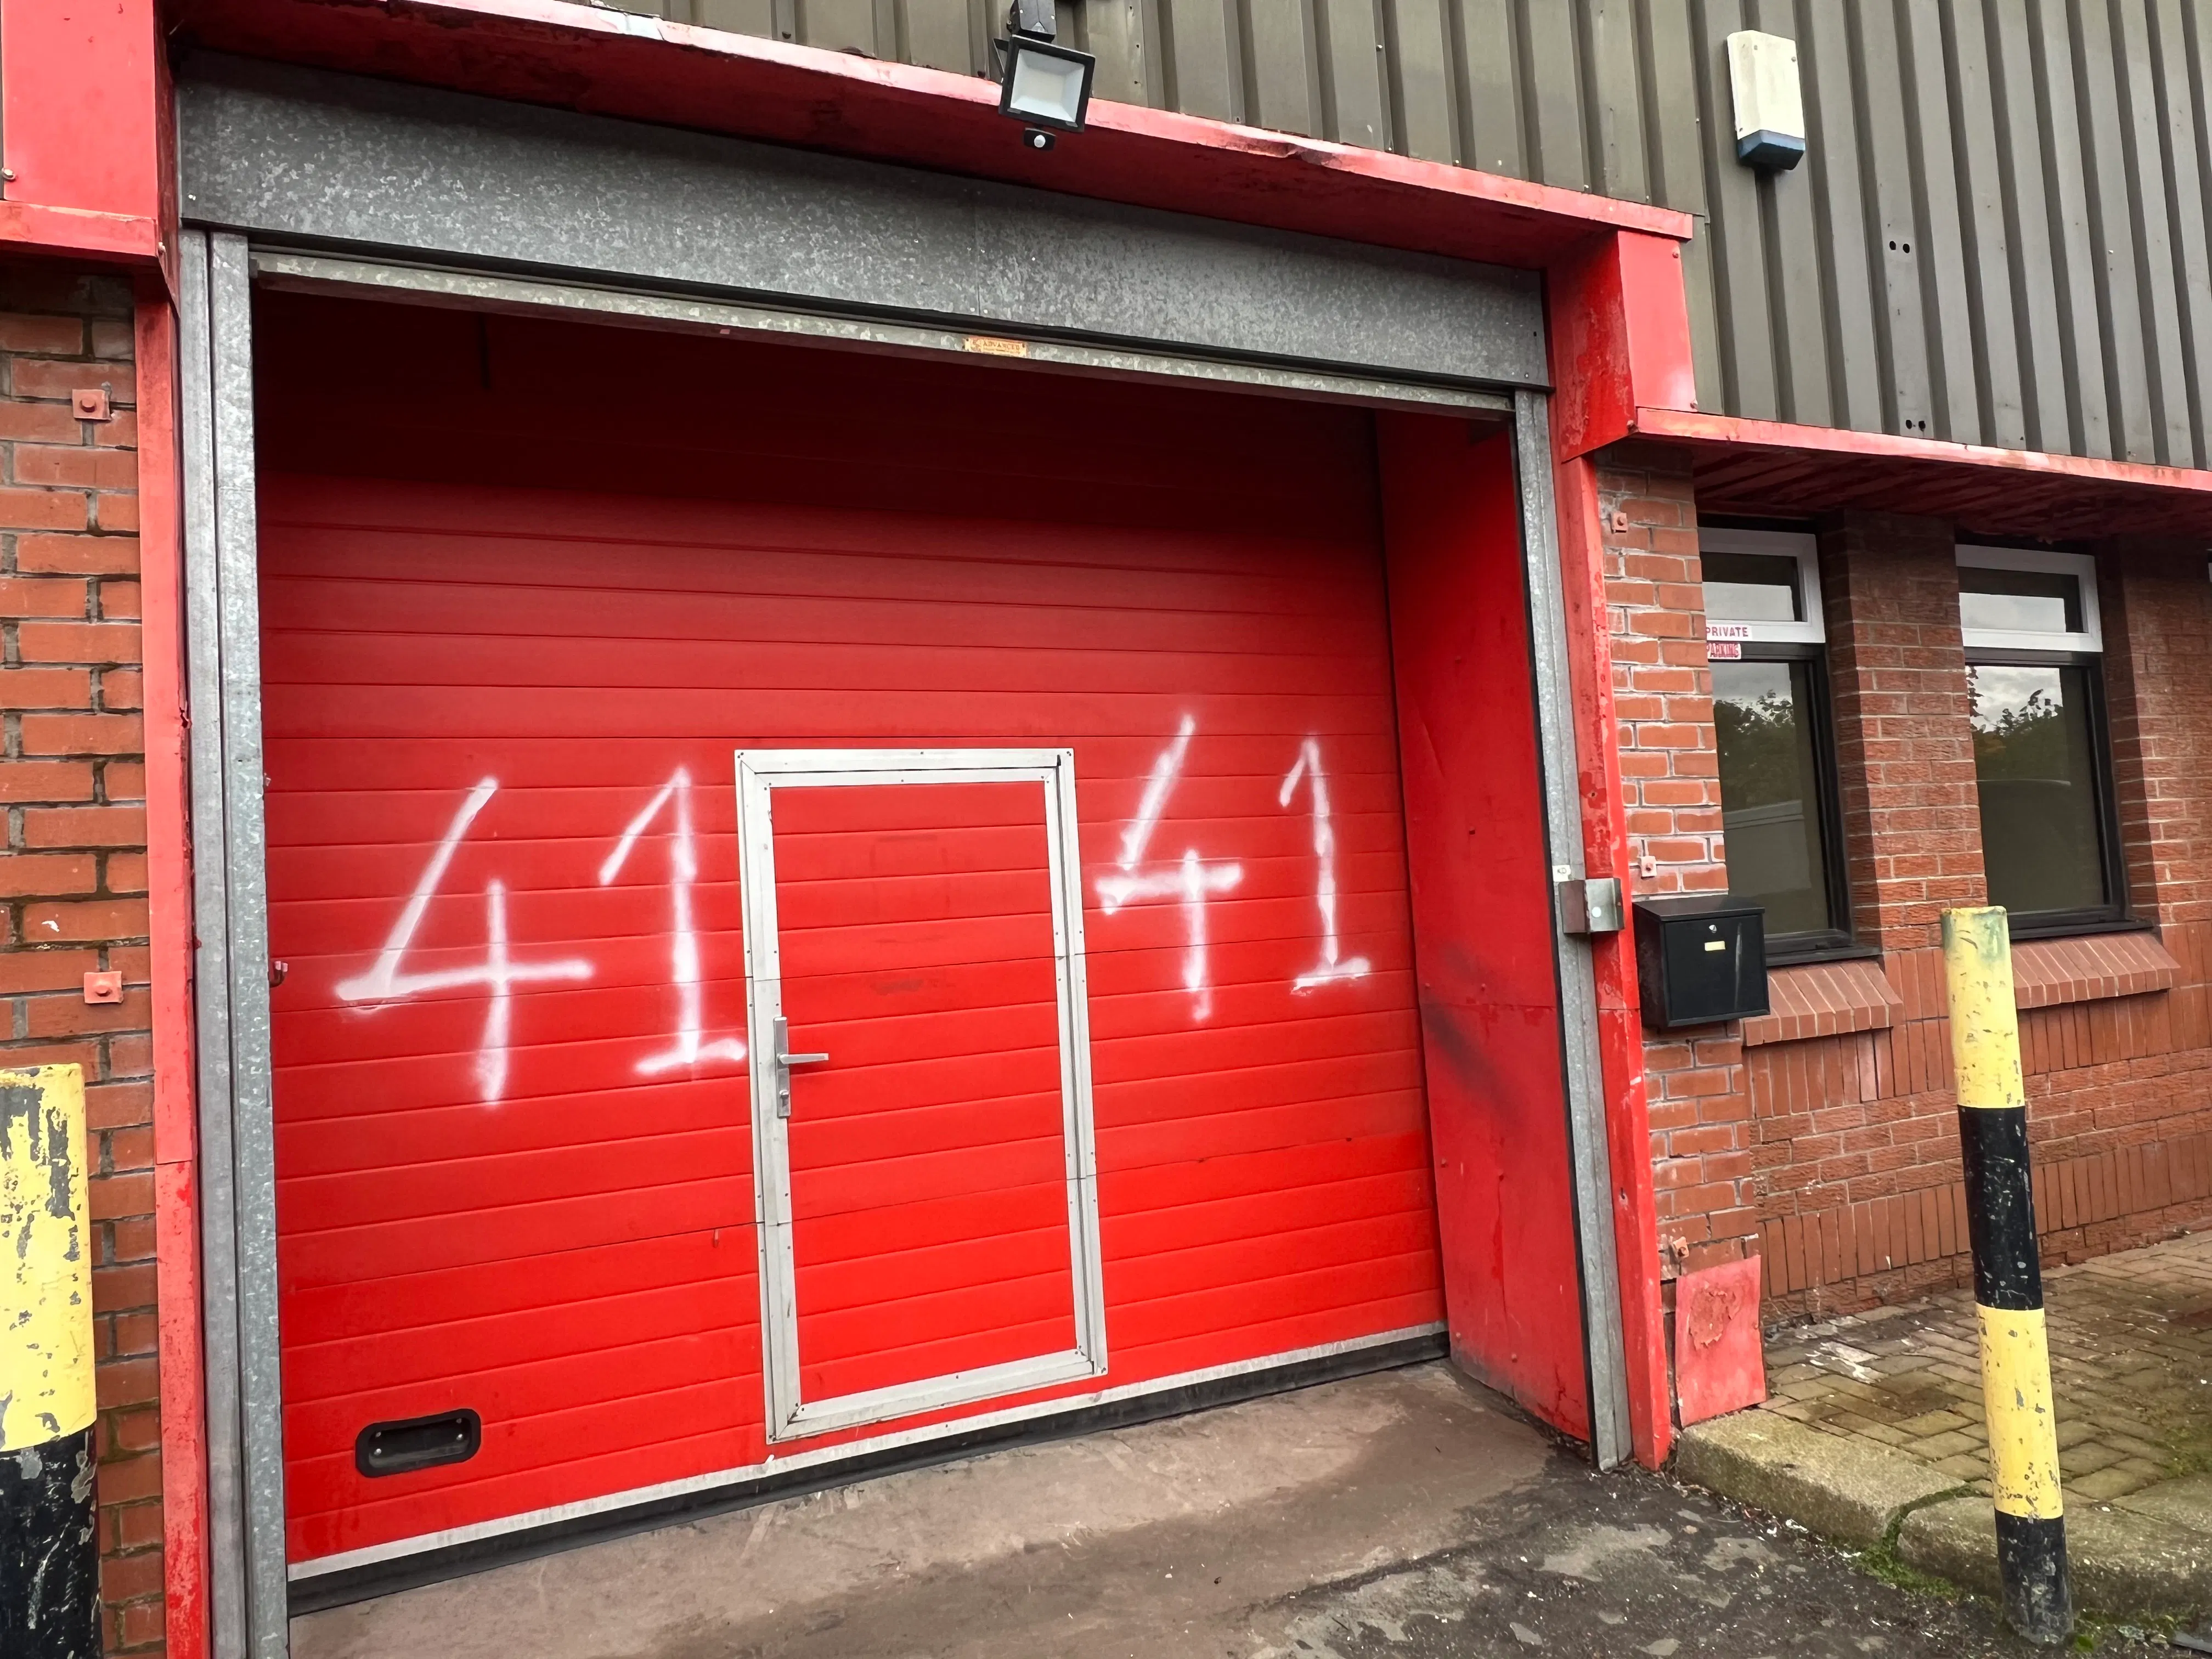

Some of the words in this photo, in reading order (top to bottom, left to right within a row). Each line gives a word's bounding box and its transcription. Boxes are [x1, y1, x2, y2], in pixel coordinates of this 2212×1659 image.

[1706, 627, 1748, 637] PRIVATE
[336, 767, 746, 1105] 41
[1097, 714, 1370, 1020] 41
